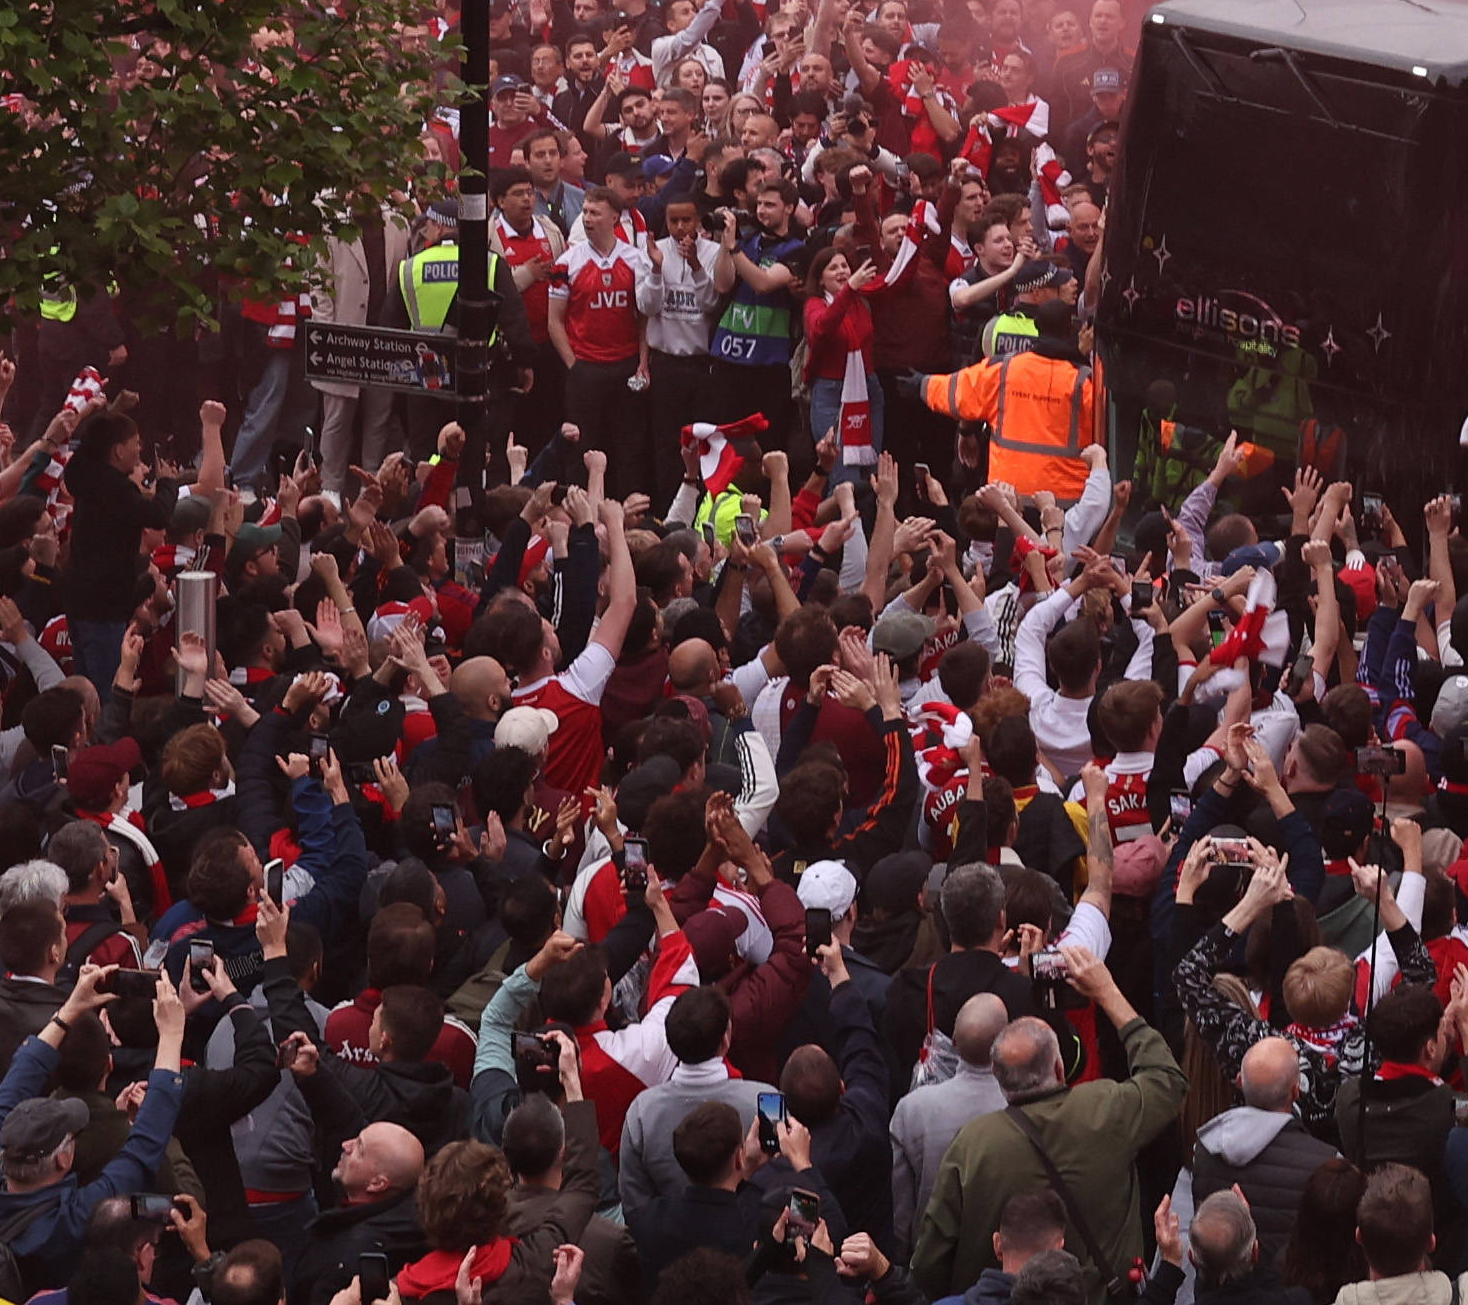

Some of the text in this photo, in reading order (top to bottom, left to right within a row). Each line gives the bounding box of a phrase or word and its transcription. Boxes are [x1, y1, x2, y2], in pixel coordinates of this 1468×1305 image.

[424, 263, 459, 279] POLIC
[590, 290, 628, 309] JVC
[1176, 294, 1301, 349] ellisons
[326, 331, 412, 353] Archway Station
[721, 335, 757, 358] 057
[997, 335, 1034, 354] POLIC
[326, 352, 357, 369] Angel
[930, 784, 965, 821] AUBA
